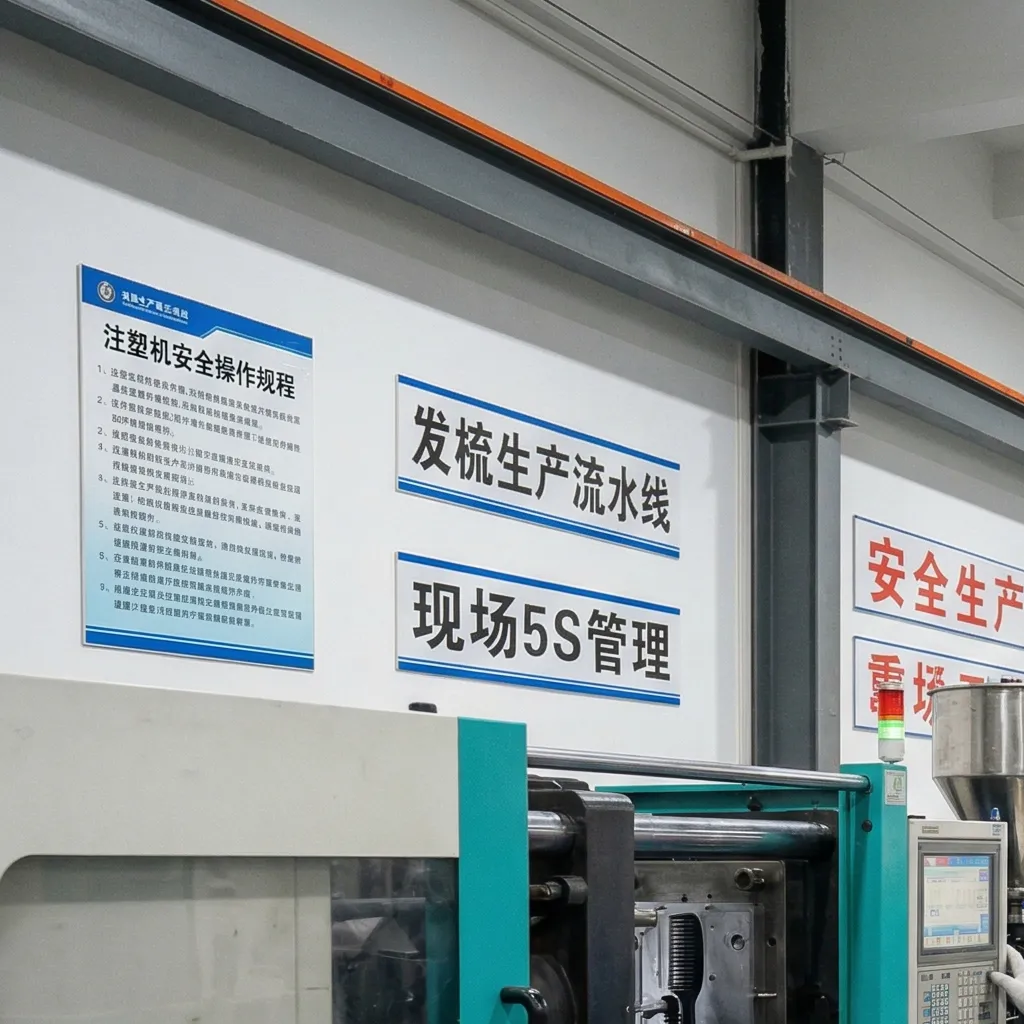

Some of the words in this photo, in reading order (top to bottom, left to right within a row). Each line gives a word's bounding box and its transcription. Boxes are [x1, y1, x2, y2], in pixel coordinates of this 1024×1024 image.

[103, 323, 295, 400] 注塑机安全操作规程
[412, 404, 671, 533] 发梳生产流水线
[412, 581, 671, 682] 现场5S管理
[868, 537, 1024, 632] 安全生产
